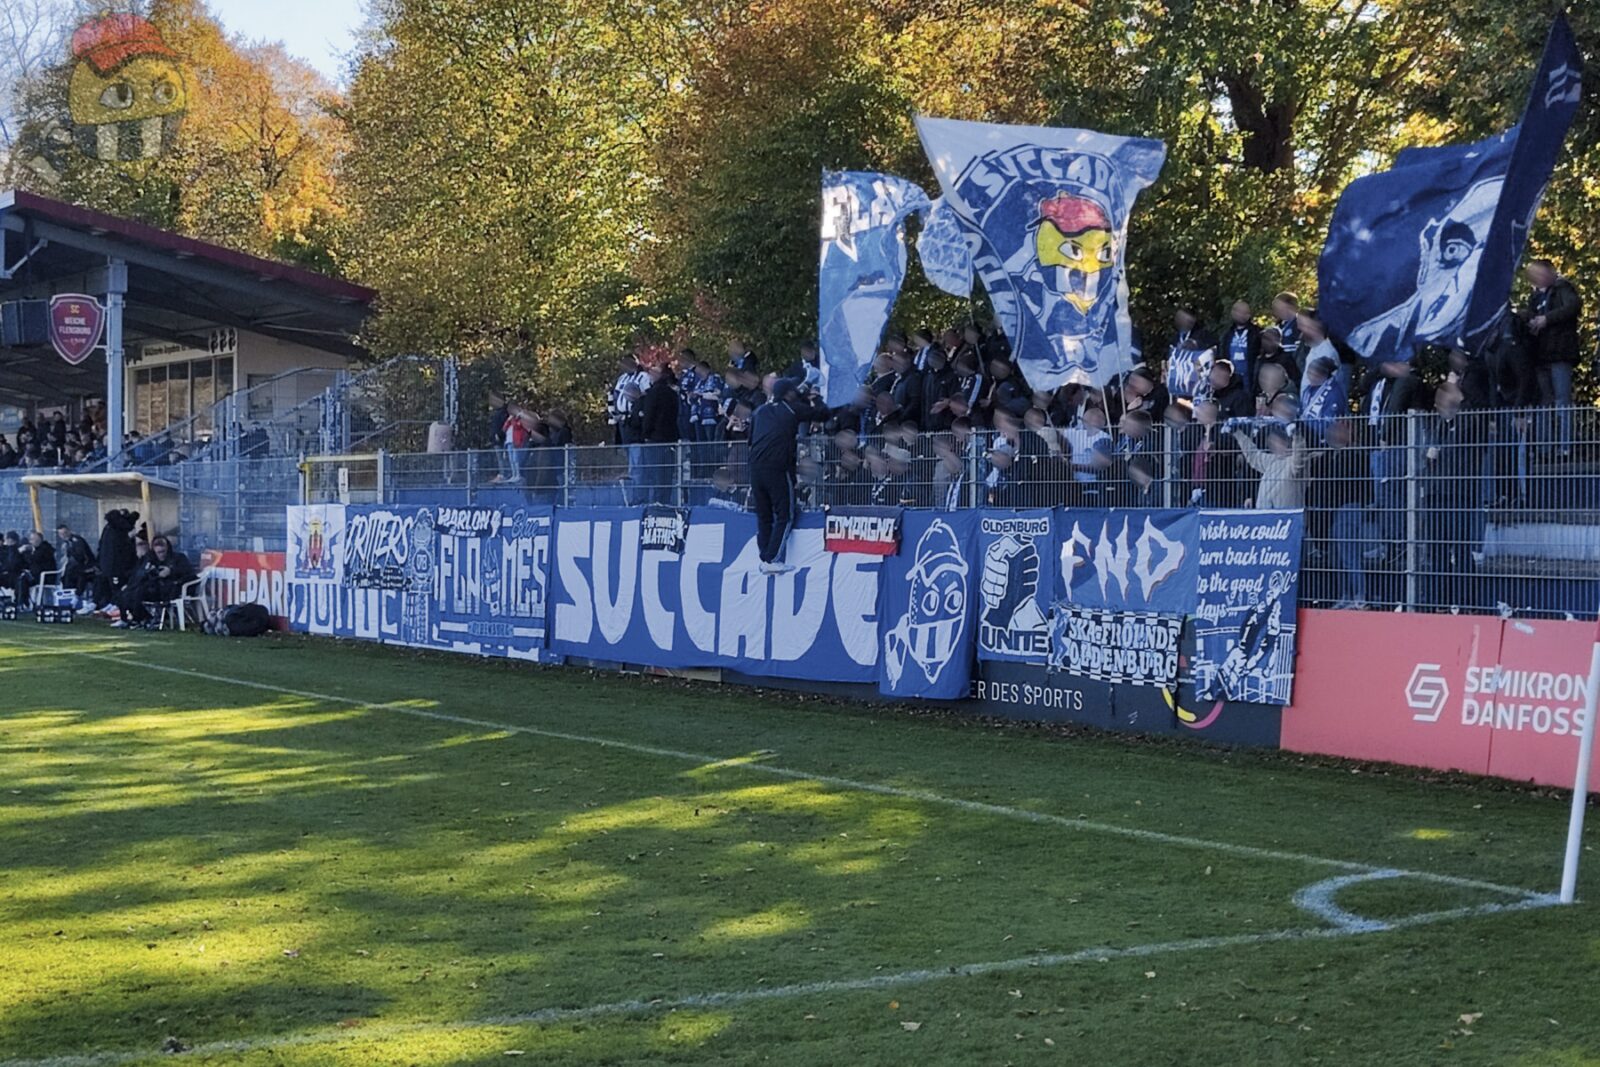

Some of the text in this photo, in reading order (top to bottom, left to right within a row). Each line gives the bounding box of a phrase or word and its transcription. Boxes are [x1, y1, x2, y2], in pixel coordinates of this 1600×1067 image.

[981, 518, 1048, 534] OLDENBURG
[1230, 524, 1250, 540] we
[1250, 519, 1292, 540] could
[1225, 545, 1258, 566] back
[555, 517, 885, 666] SUCCADE
[1210, 571, 1229, 593] the
[1230, 573, 1264, 599] good
[1069, 641, 1178, 679] OLDENBURG
[991, 682, 1019, 703] DES
[1023, 685, 1083, 711] SPORTS
[1464, 666, 1589, 702] SEMIKRON
[1461, 698, 1586, 737] DANFOSS
